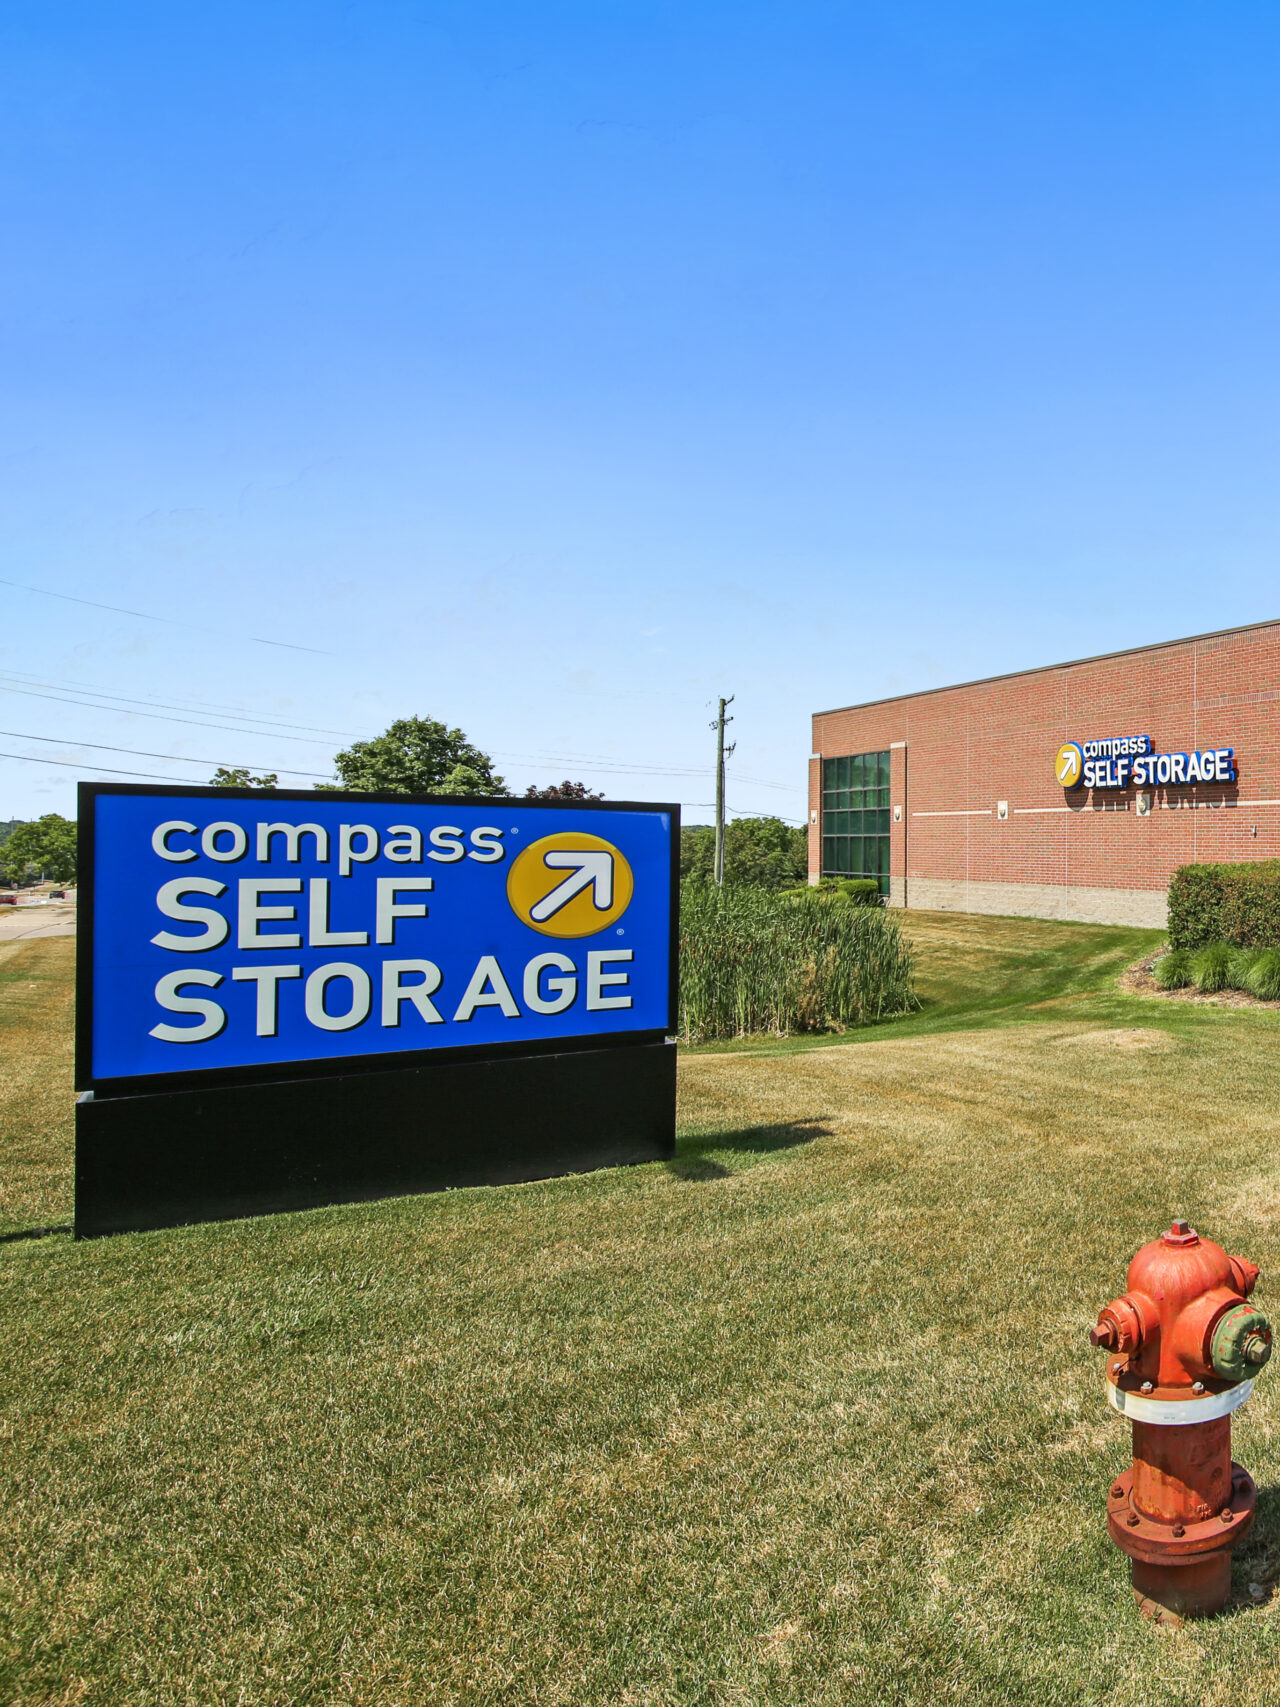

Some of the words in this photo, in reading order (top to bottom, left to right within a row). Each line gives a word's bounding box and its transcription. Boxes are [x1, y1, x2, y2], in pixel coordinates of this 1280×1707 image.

[1083, 737, 1147, 760] compass
[1083, 759, 1128, 788] SELF
[1132, 750, 1230, 785] STORAGE
[150, 876, 434, 953] SELF
[148, 949, 633, 1043] STORAGE
